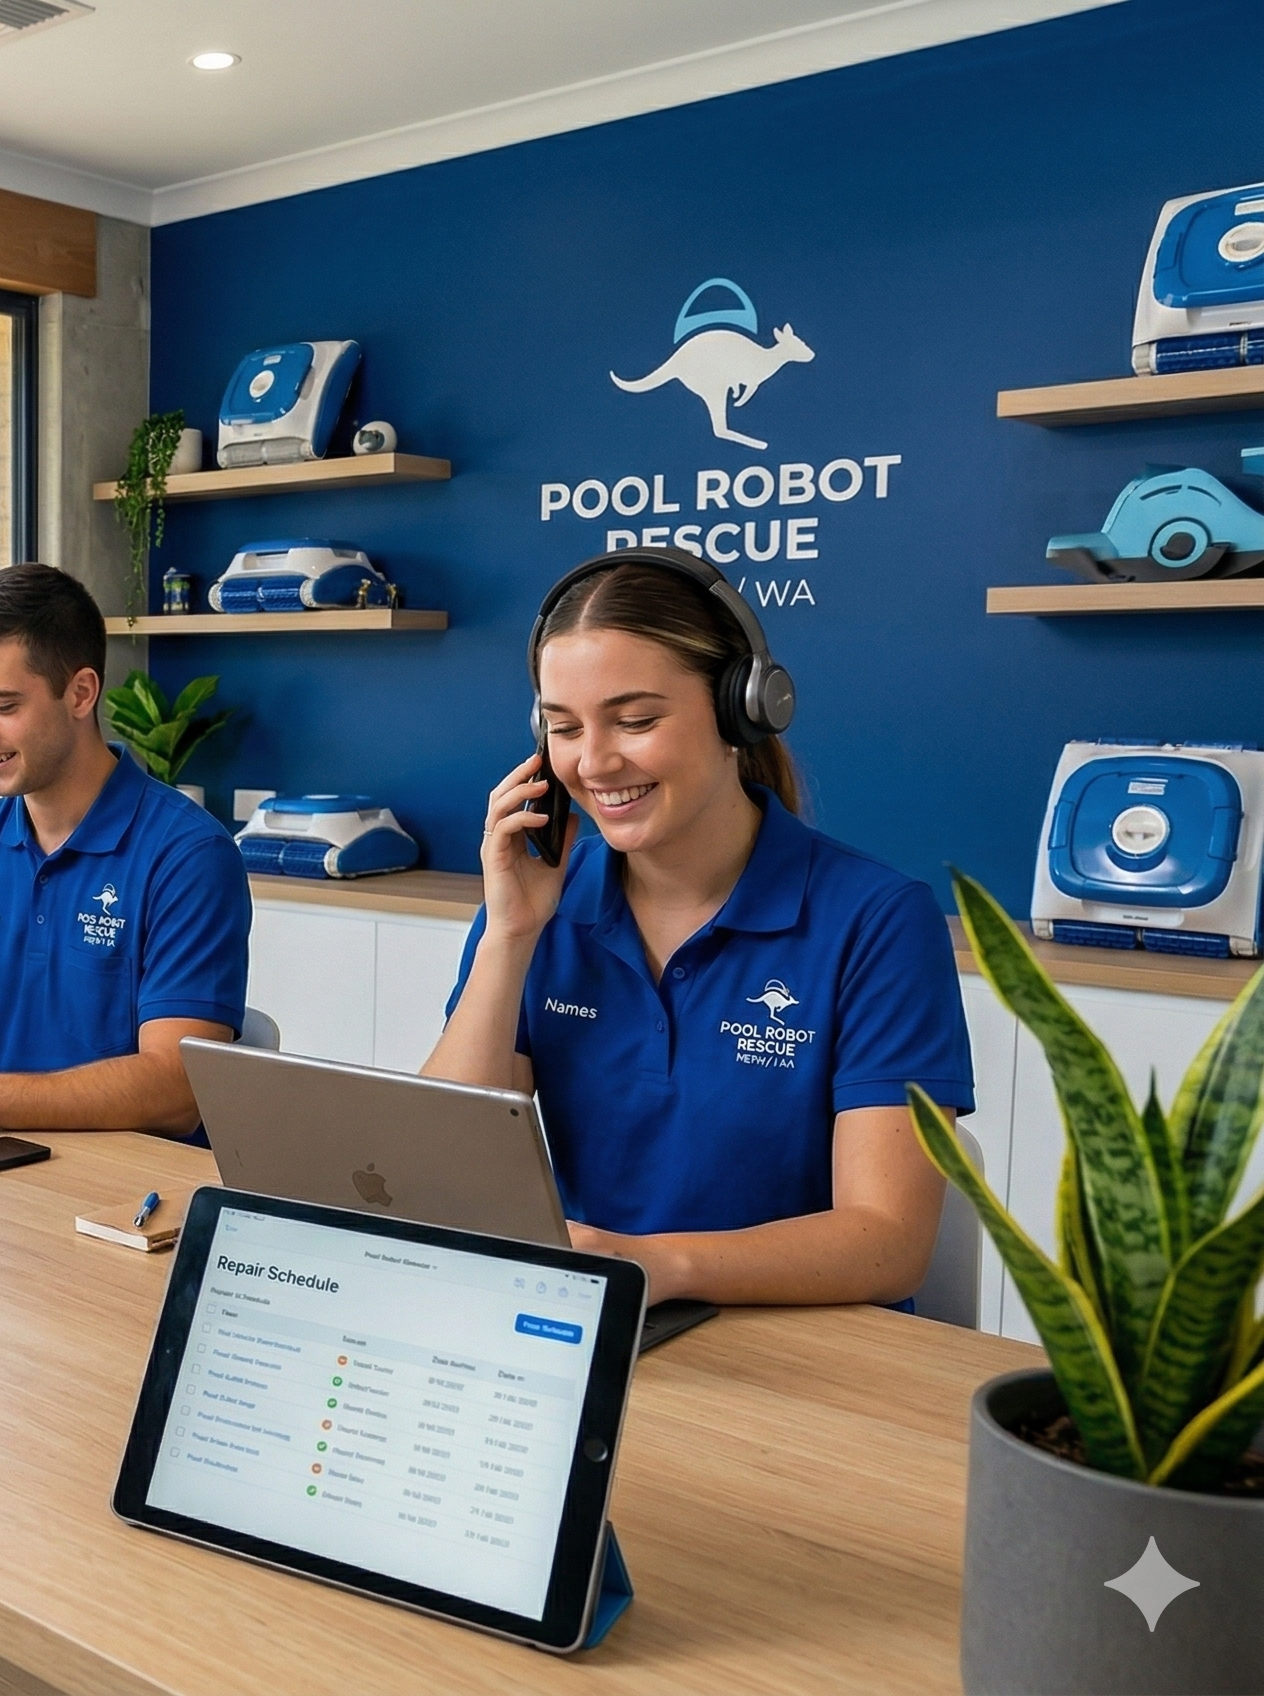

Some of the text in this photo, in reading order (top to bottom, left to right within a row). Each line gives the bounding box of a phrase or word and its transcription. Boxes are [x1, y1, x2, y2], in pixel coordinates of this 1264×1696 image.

[540, 453, 902, 522] POOL ROBOT
[755, 578, 816, 608] WA
[544, 996, 598, 1019] Names
[720, 1020, 816, 1044] POOL ROBOT
[737, 1037, 796, 1057] RESCUE
[217, 1254, 340, 1294] Repair Schedule
